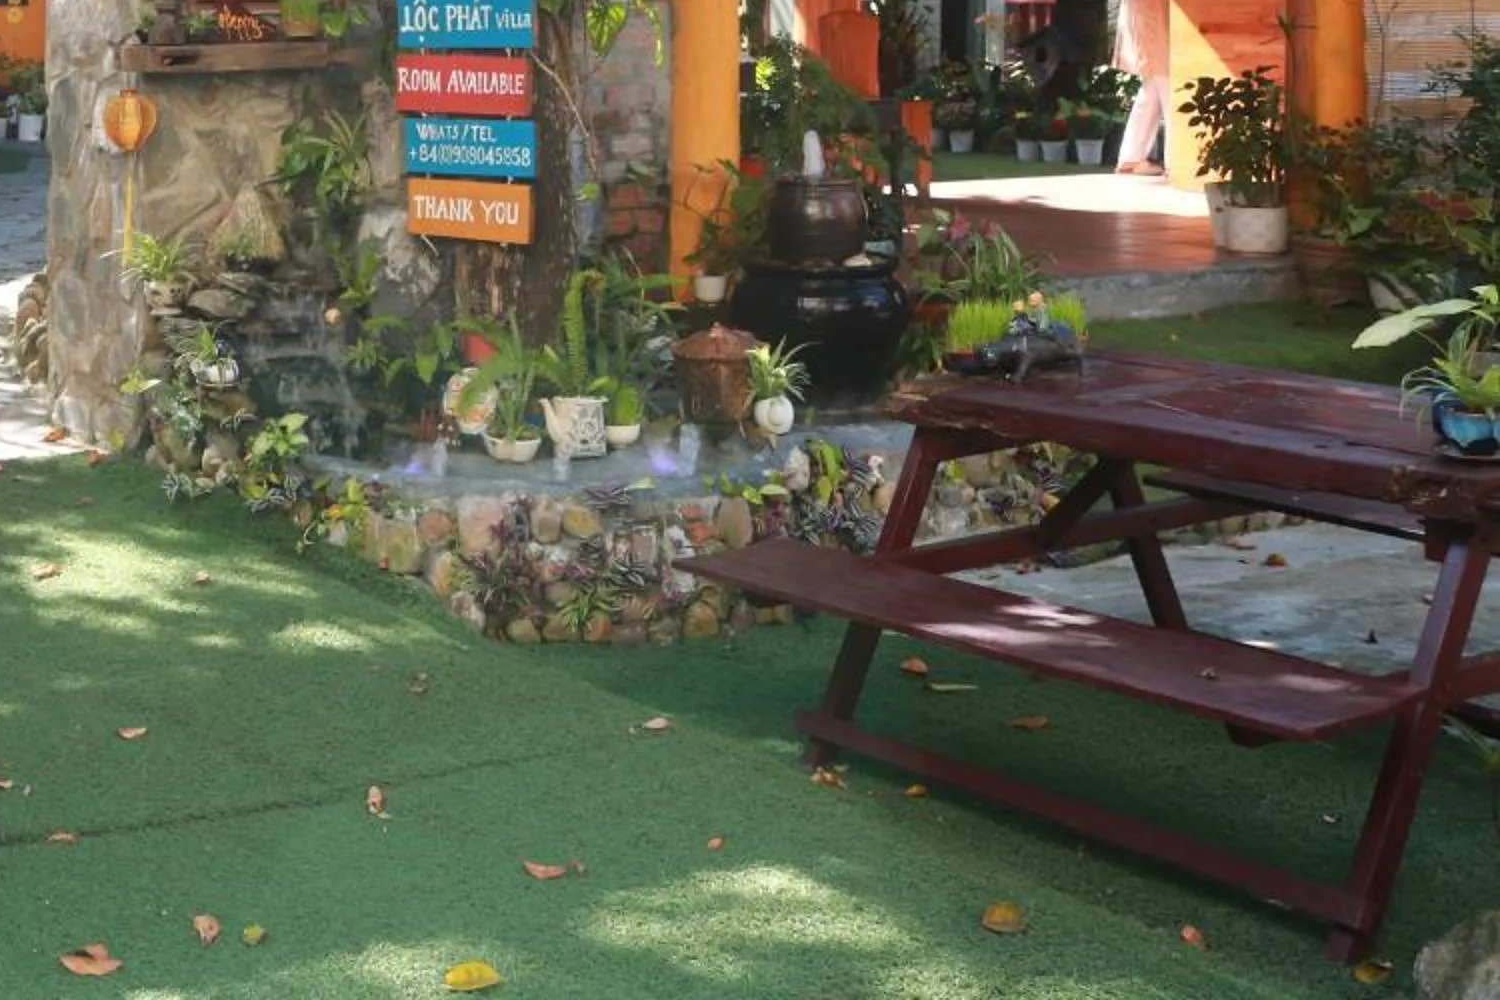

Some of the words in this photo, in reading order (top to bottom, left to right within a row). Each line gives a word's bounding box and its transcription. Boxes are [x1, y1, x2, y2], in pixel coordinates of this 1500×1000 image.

[397, 67, 442, 94] ROOM
[446, 68, 525, 96] AVAILABLE
[412, 194, 475, 224] THANK
[480, 199, 519, 226] YOU
